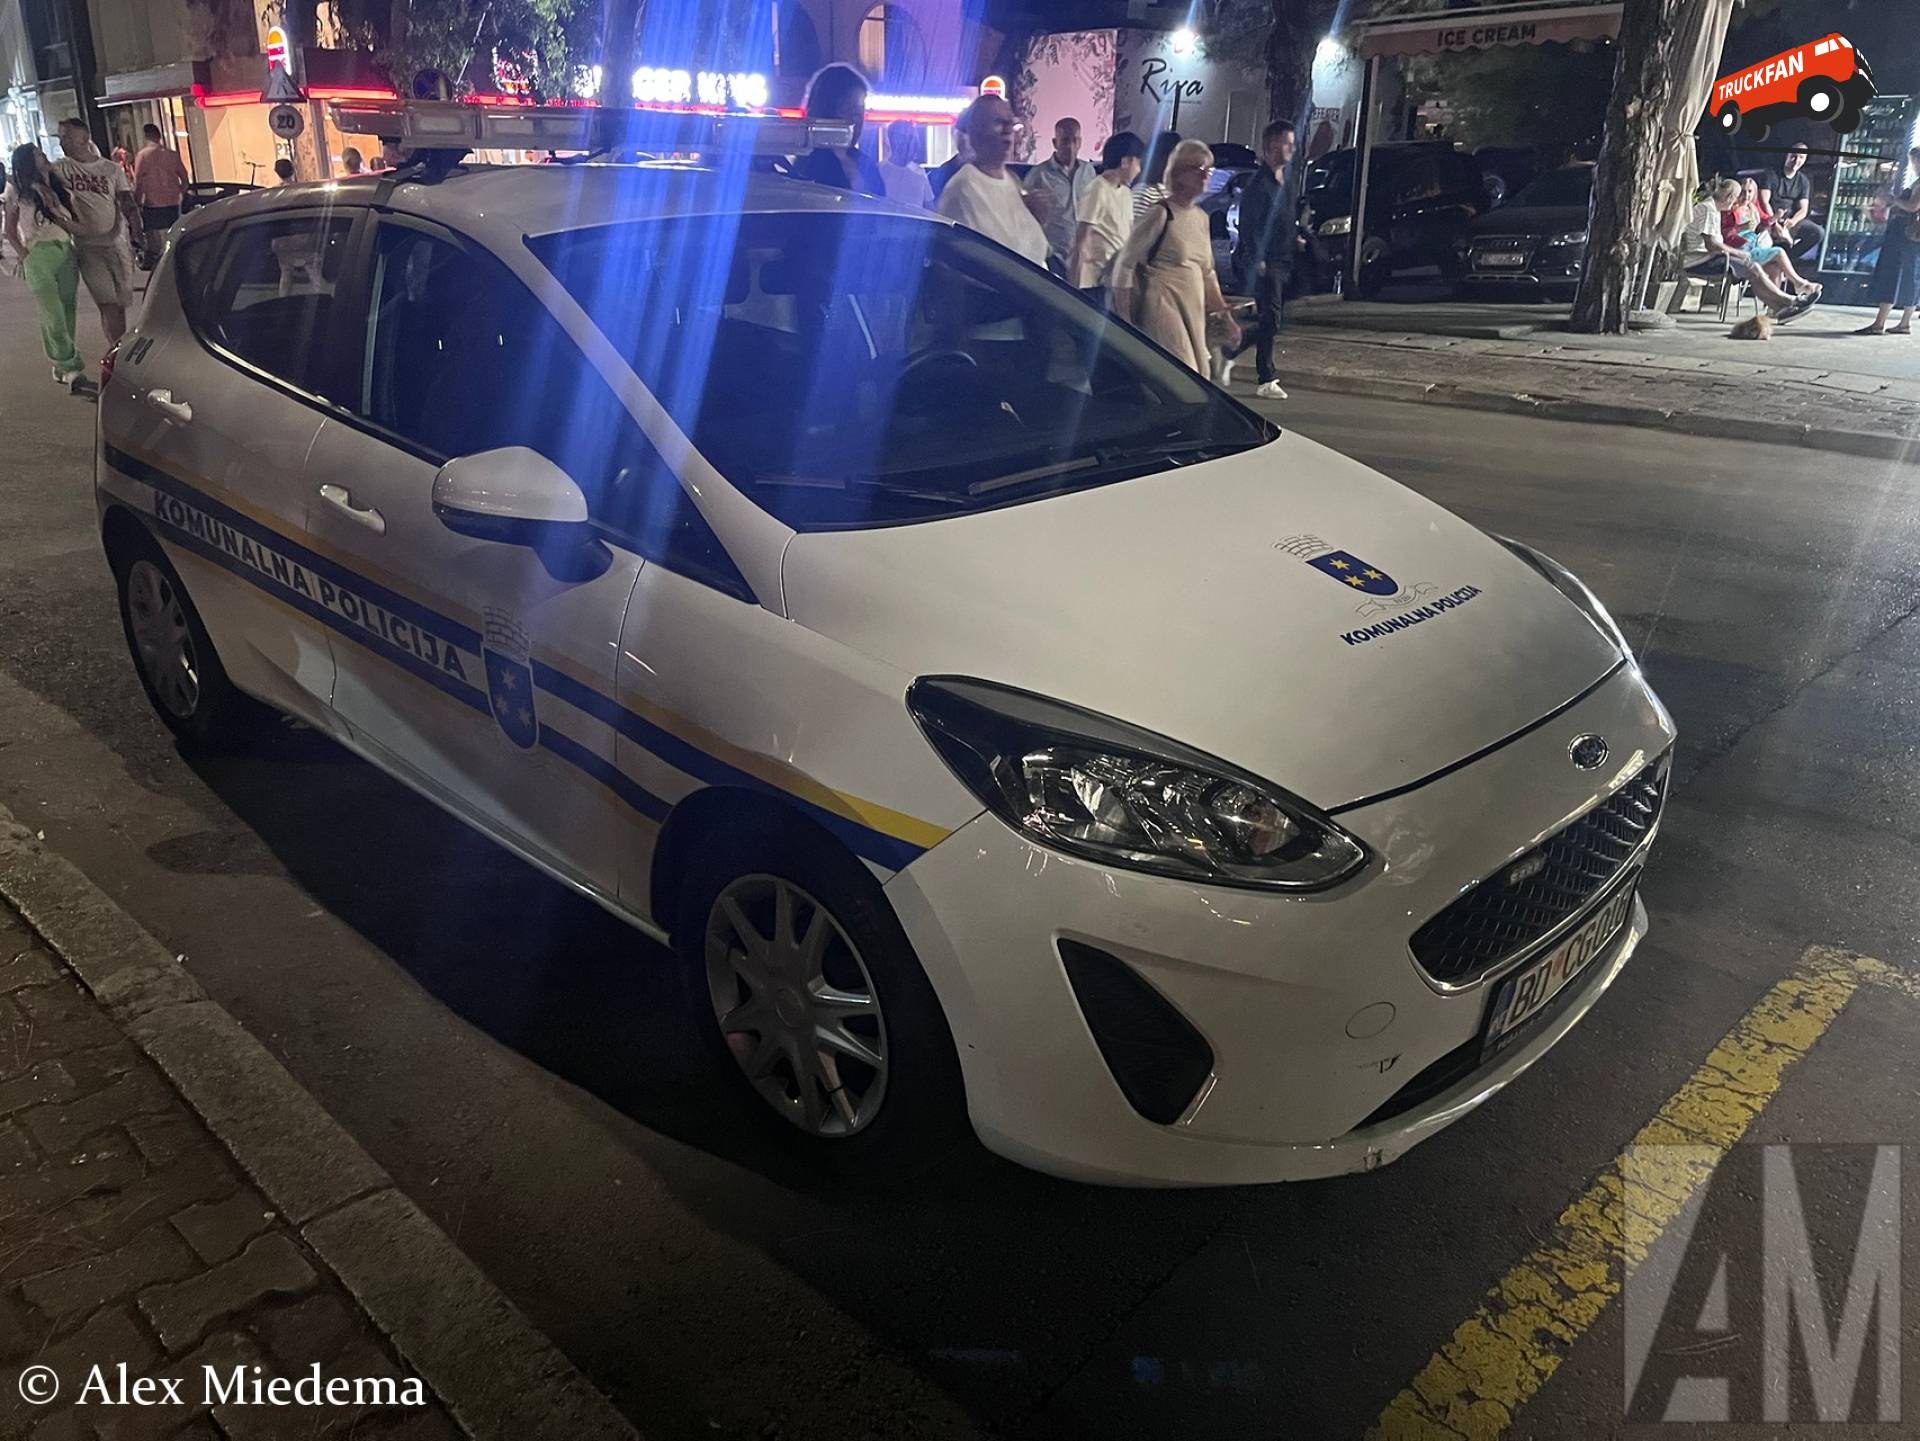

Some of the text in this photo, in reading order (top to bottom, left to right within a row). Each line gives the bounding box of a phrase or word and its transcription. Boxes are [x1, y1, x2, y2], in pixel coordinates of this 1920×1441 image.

[1437, 23, 1537, 46] ICE CREAM
[277, 114, 295, 129] 20
[153, 490, 468, 681] KOMUNALNA POLICIJA
[1340, 584, 1483, 646] KOMUNALNA POLICIJA
